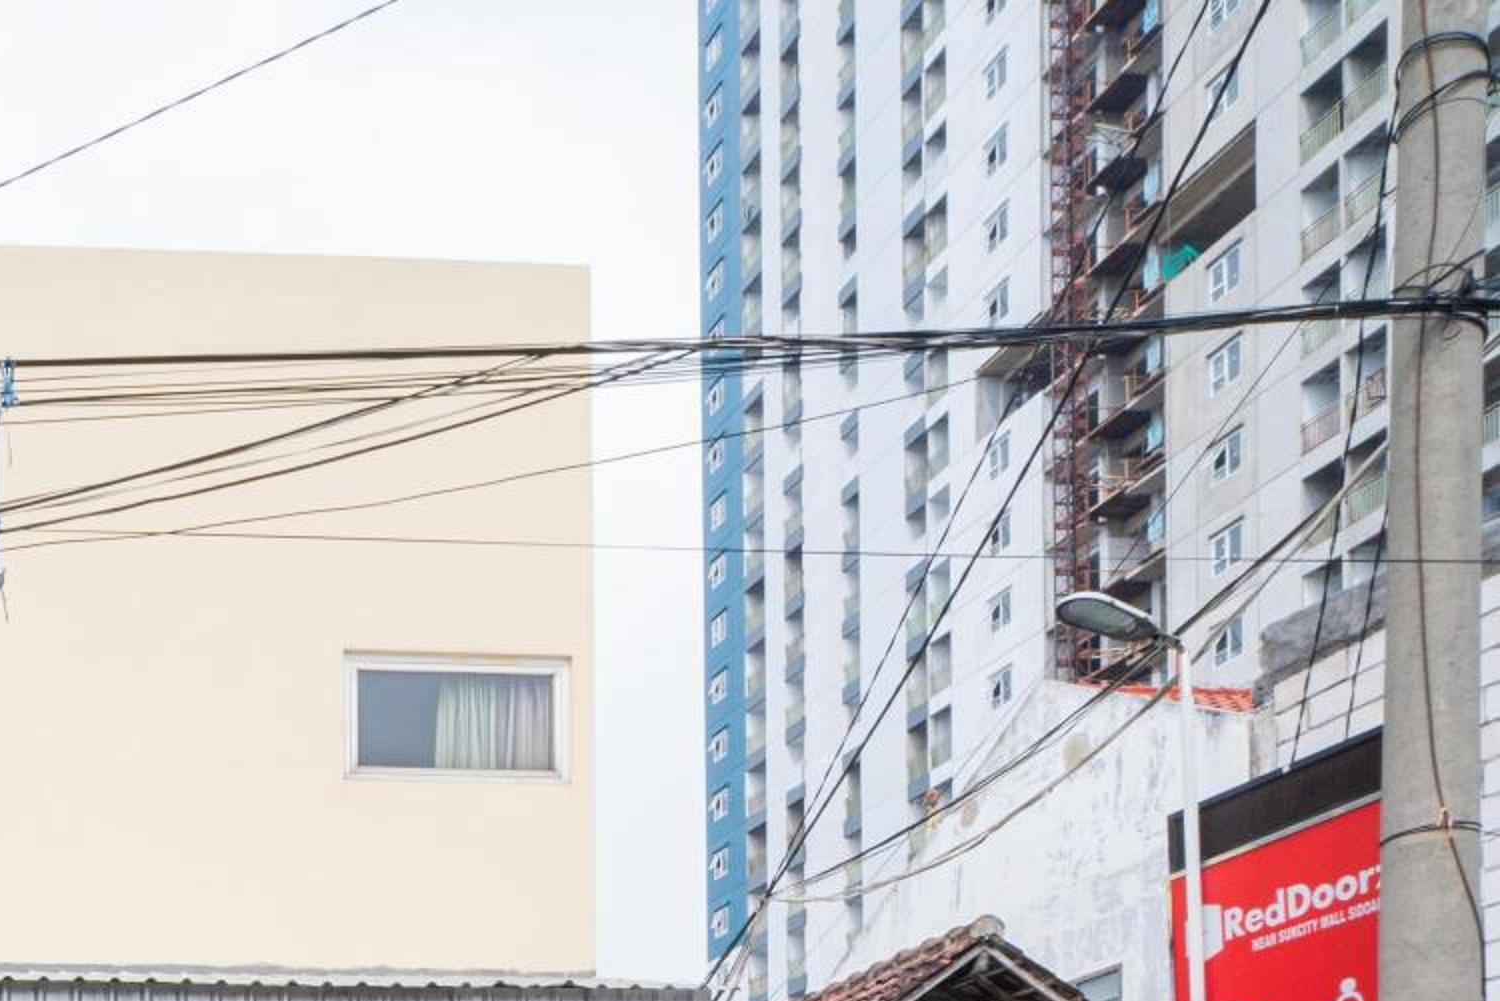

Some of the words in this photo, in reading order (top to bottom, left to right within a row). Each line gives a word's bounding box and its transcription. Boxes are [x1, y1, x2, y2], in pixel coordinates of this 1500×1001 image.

[1252, 935, 1277, 951] NEAR
[1278, 919, 1318, 943] SUNCITY
[1320, 911, 1346, 929] MALL
